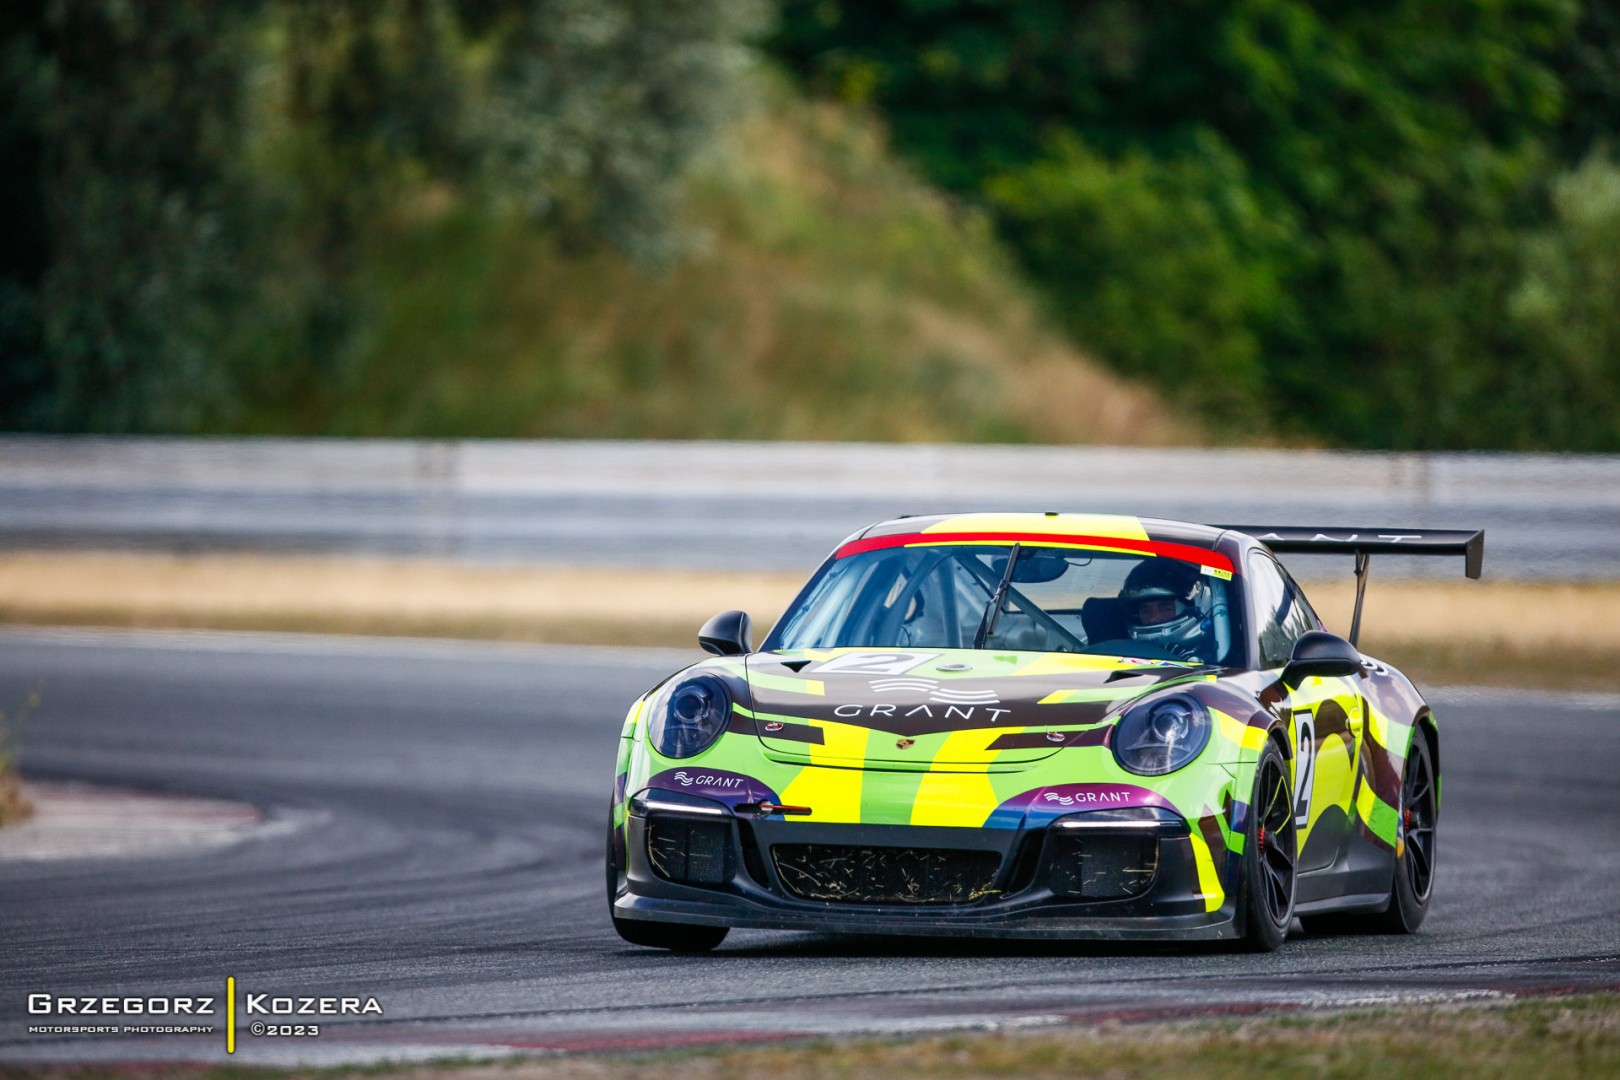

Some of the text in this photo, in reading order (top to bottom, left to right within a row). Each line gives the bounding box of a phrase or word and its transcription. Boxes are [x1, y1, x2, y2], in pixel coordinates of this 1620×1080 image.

[828, 653, 916, 672] 2
[833, 703, 1012, 723] GRANT
[1295, 721, 1312, 817] 2
[695, 775, 744, 788] GRANT
[1075, 792, 1130, 802] GRANT
